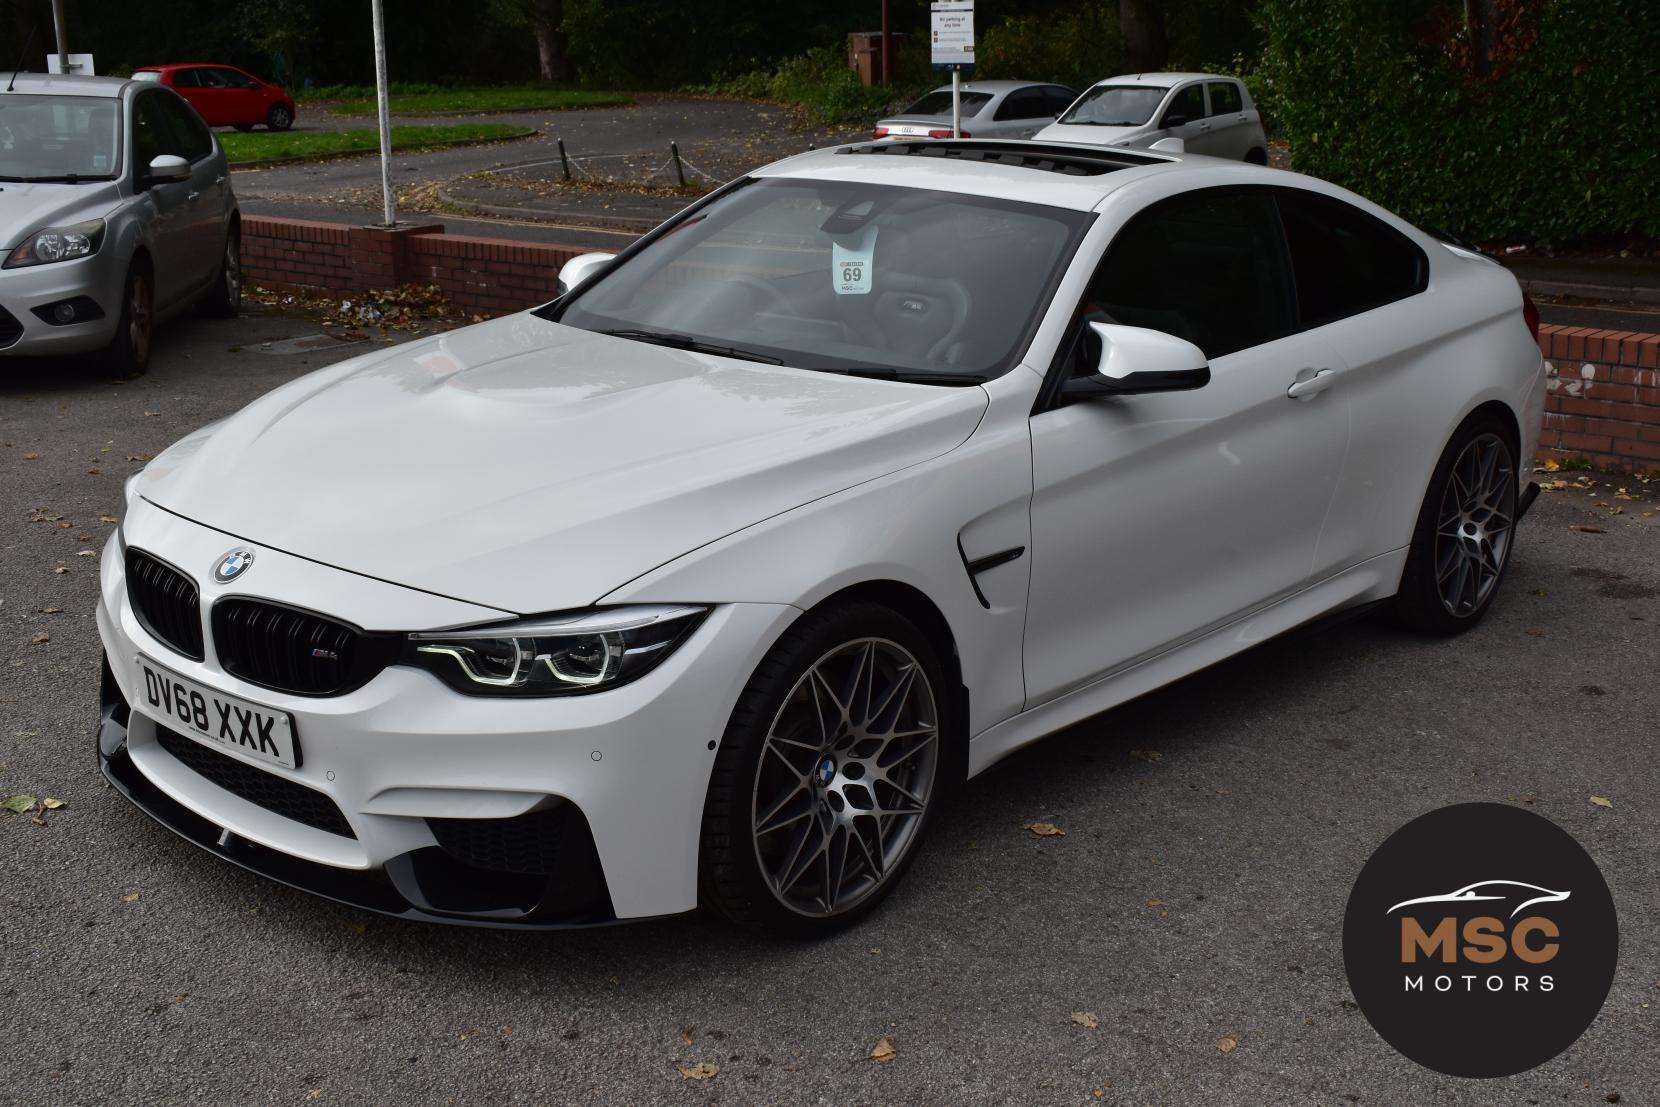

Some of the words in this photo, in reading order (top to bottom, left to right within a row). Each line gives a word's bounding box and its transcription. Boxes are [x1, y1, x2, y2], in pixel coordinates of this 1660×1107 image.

[843, 267, 861, 281] 69
[143, 665, 210, 732] DV68
[213, 698, 280, 758] XXK
